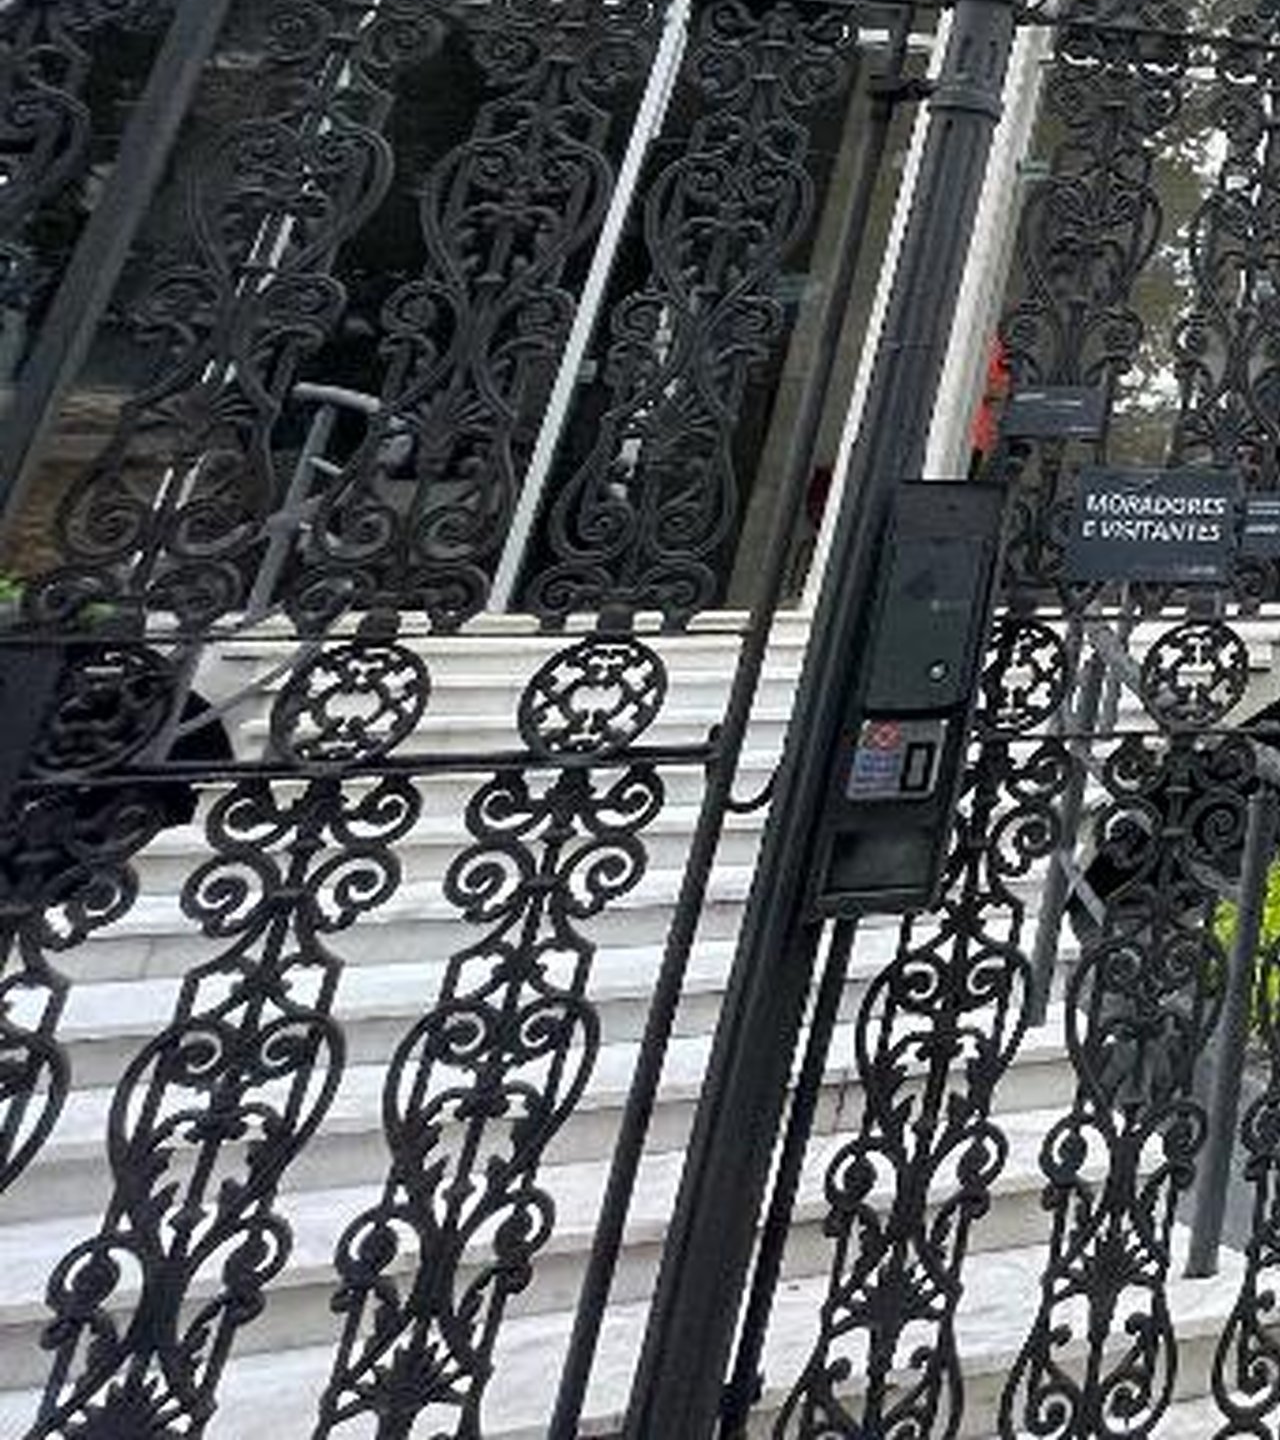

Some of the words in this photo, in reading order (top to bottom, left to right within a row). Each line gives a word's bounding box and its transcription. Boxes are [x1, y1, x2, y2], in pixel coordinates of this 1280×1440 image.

[1086, 493, 1228, 516] MORADORES
[1082, 519, 1096, 538] E
[1100, 520, 1221, 542] VISITANTES
